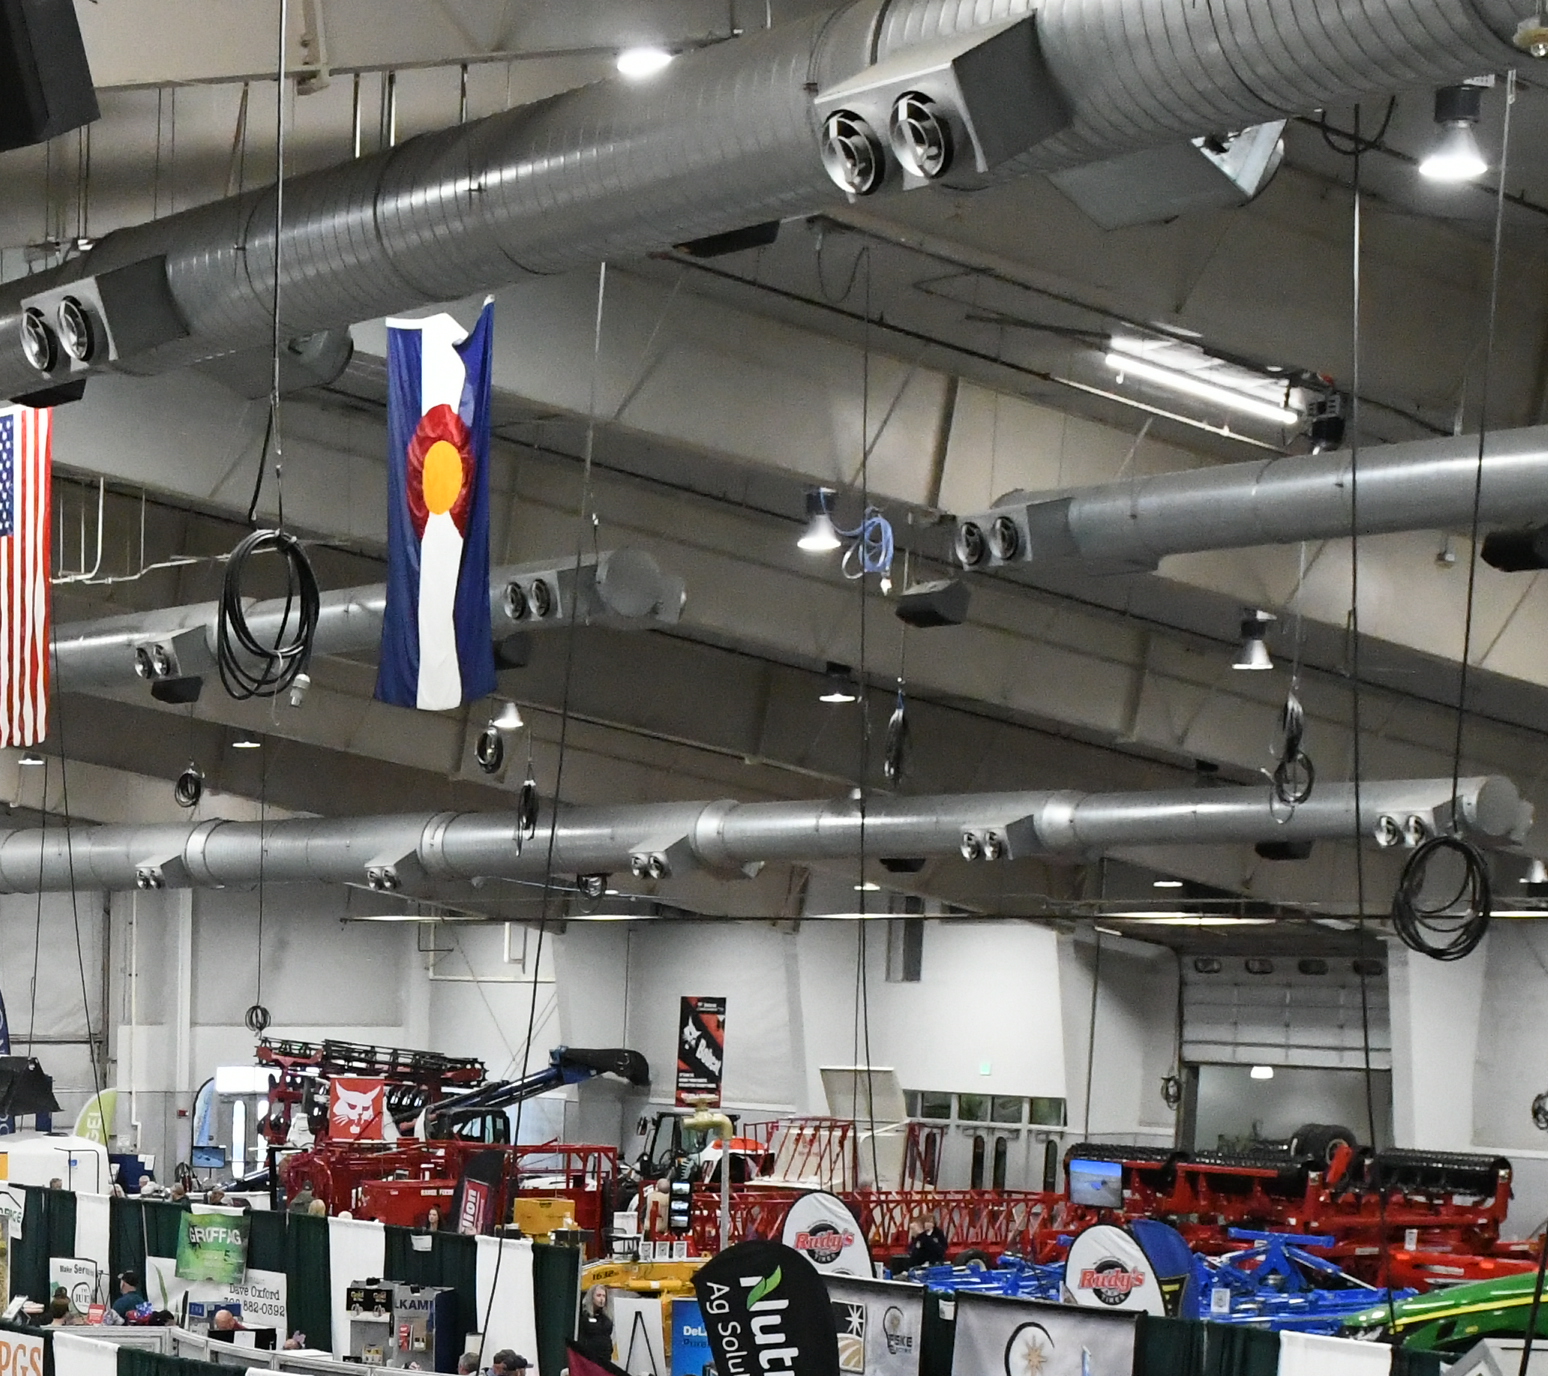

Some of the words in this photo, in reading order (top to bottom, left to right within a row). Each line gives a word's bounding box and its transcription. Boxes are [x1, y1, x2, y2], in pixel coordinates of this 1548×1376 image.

[229, 1283, 249, 1298] Dave
[251, 1286, 280, 1301] Oxford
[706, 1281, 730, 1315] Ag
[243, 1302, 285, 1318] 882-0392
